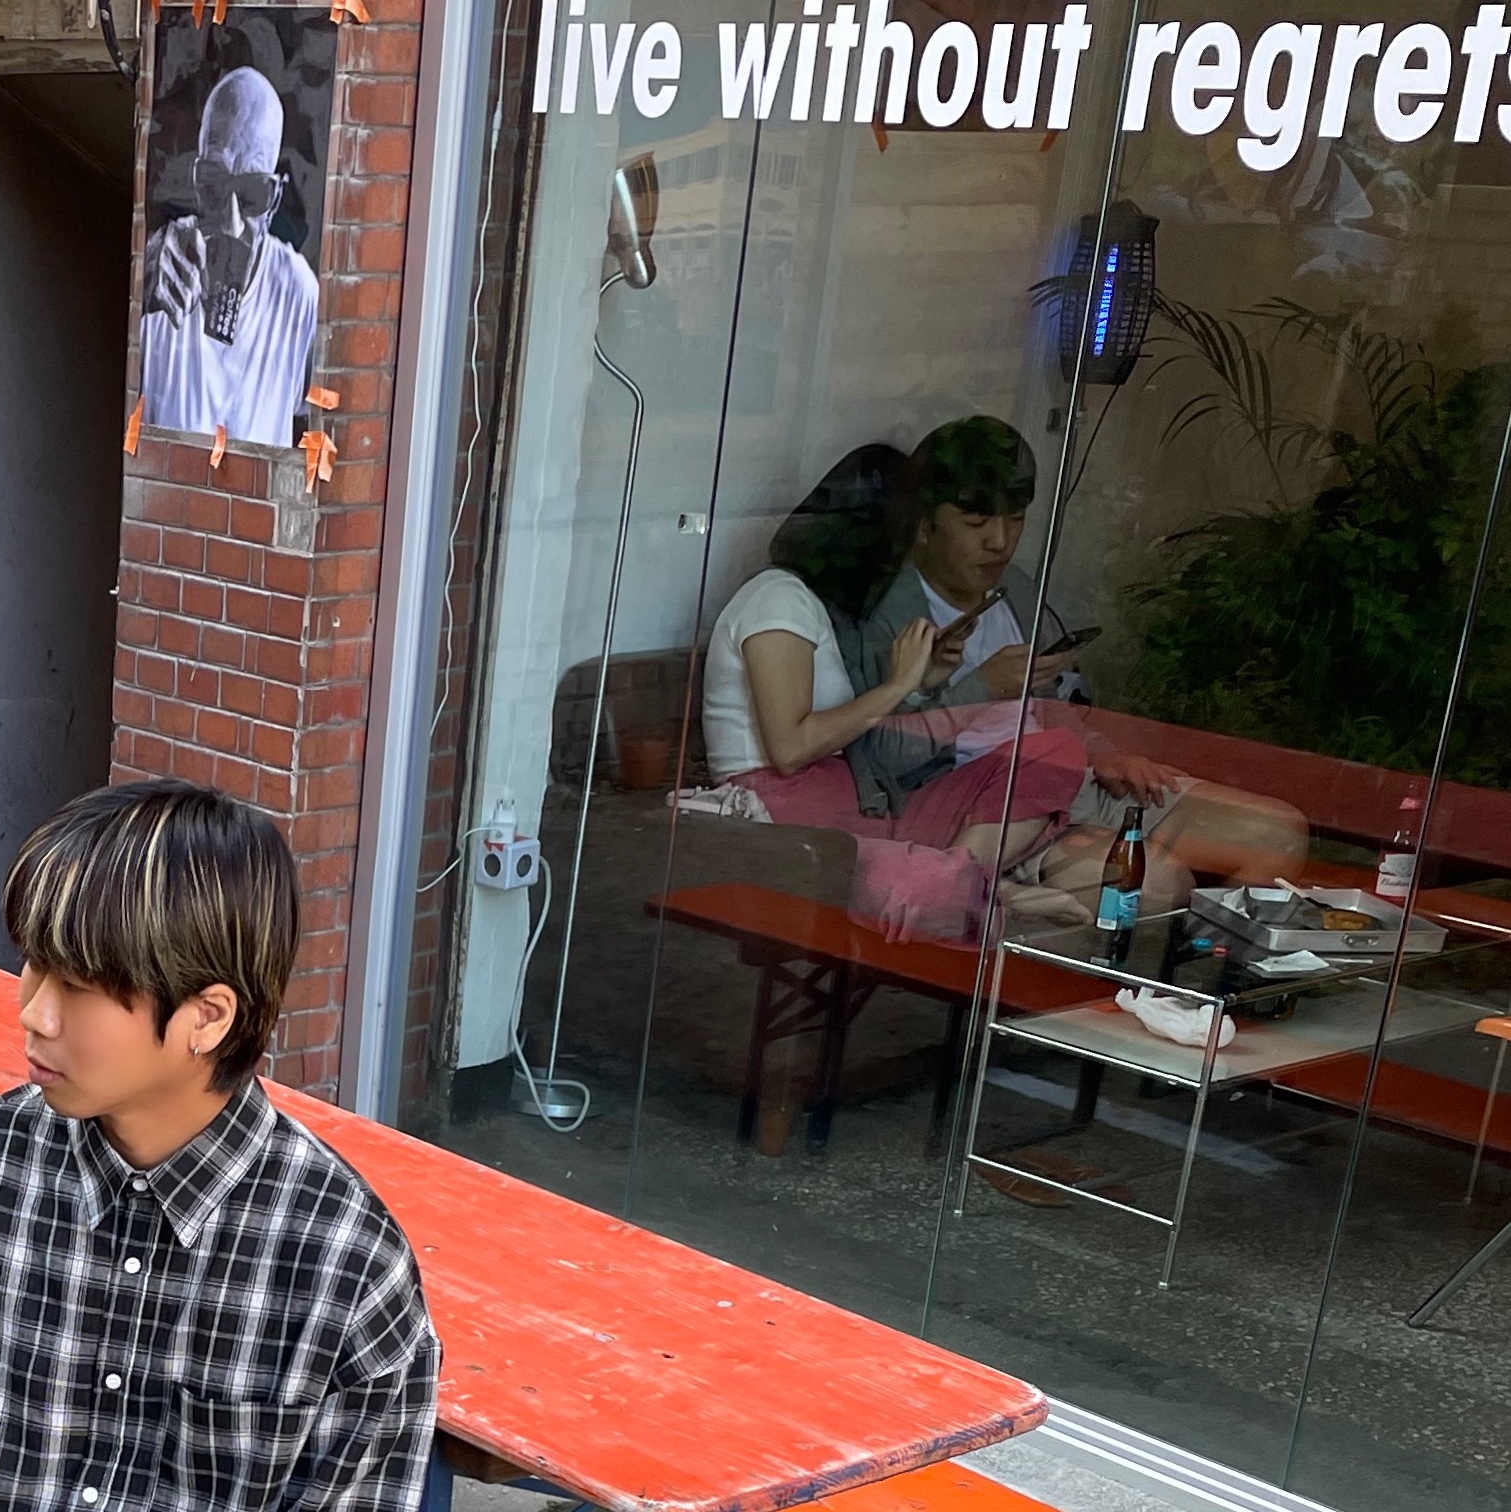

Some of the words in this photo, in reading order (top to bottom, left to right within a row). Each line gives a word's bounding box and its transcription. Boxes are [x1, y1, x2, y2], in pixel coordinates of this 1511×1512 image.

[532, 0, 682, 118] live
[718, 0, 1093, 129] without
[1121, 4, 1511, 171] regret
